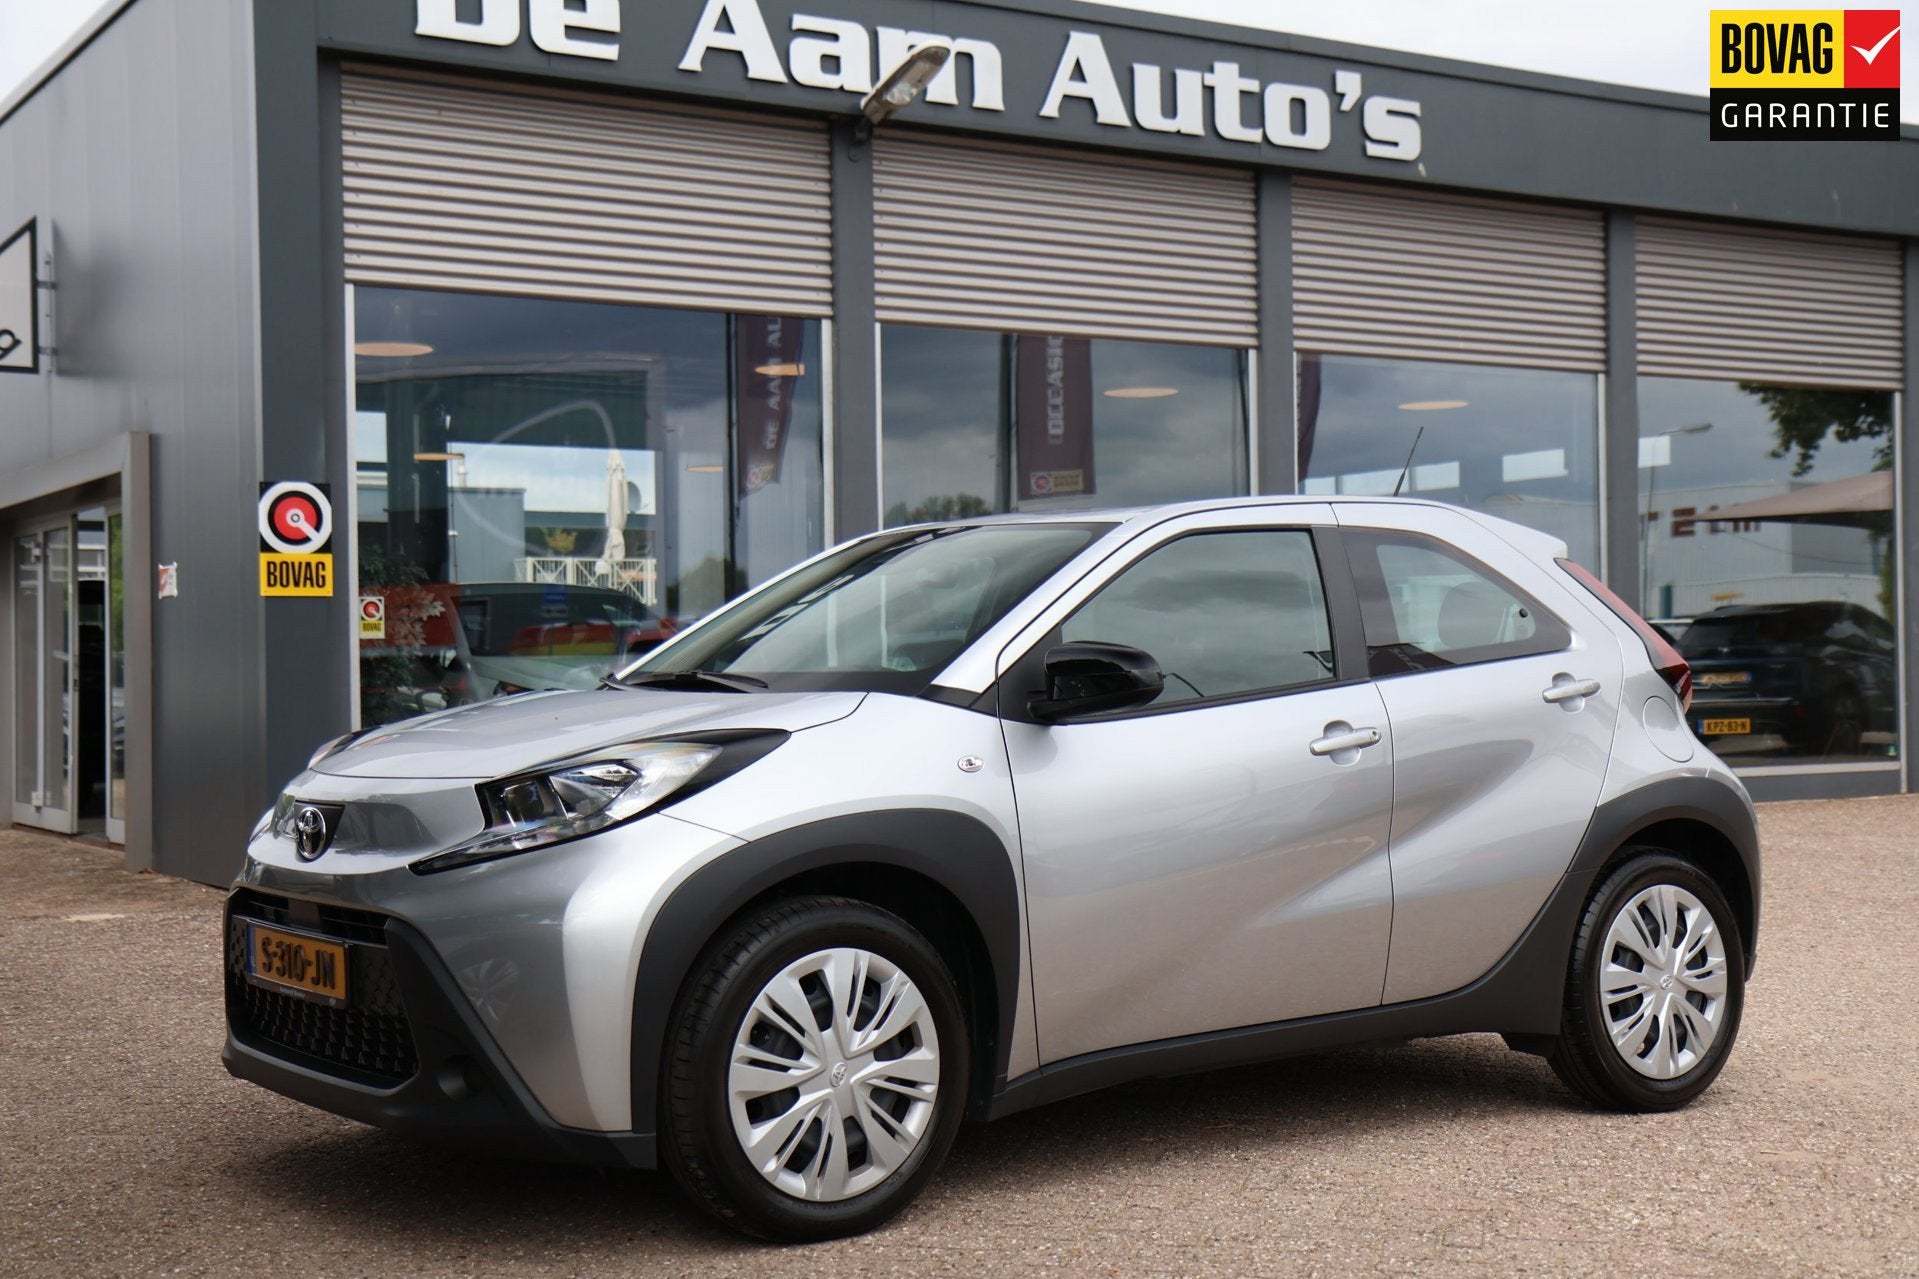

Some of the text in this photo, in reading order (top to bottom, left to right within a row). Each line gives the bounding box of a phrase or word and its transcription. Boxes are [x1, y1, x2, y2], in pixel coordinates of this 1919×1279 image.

[677, 0, 1005, 110] Aam
[1038, 31, 1422, 162] Auto's
[266, 560, 326, 588] BOVAG
[362, 621, 381, 632] BOVAG
[261, 936, 335, 990] S-310-JN
